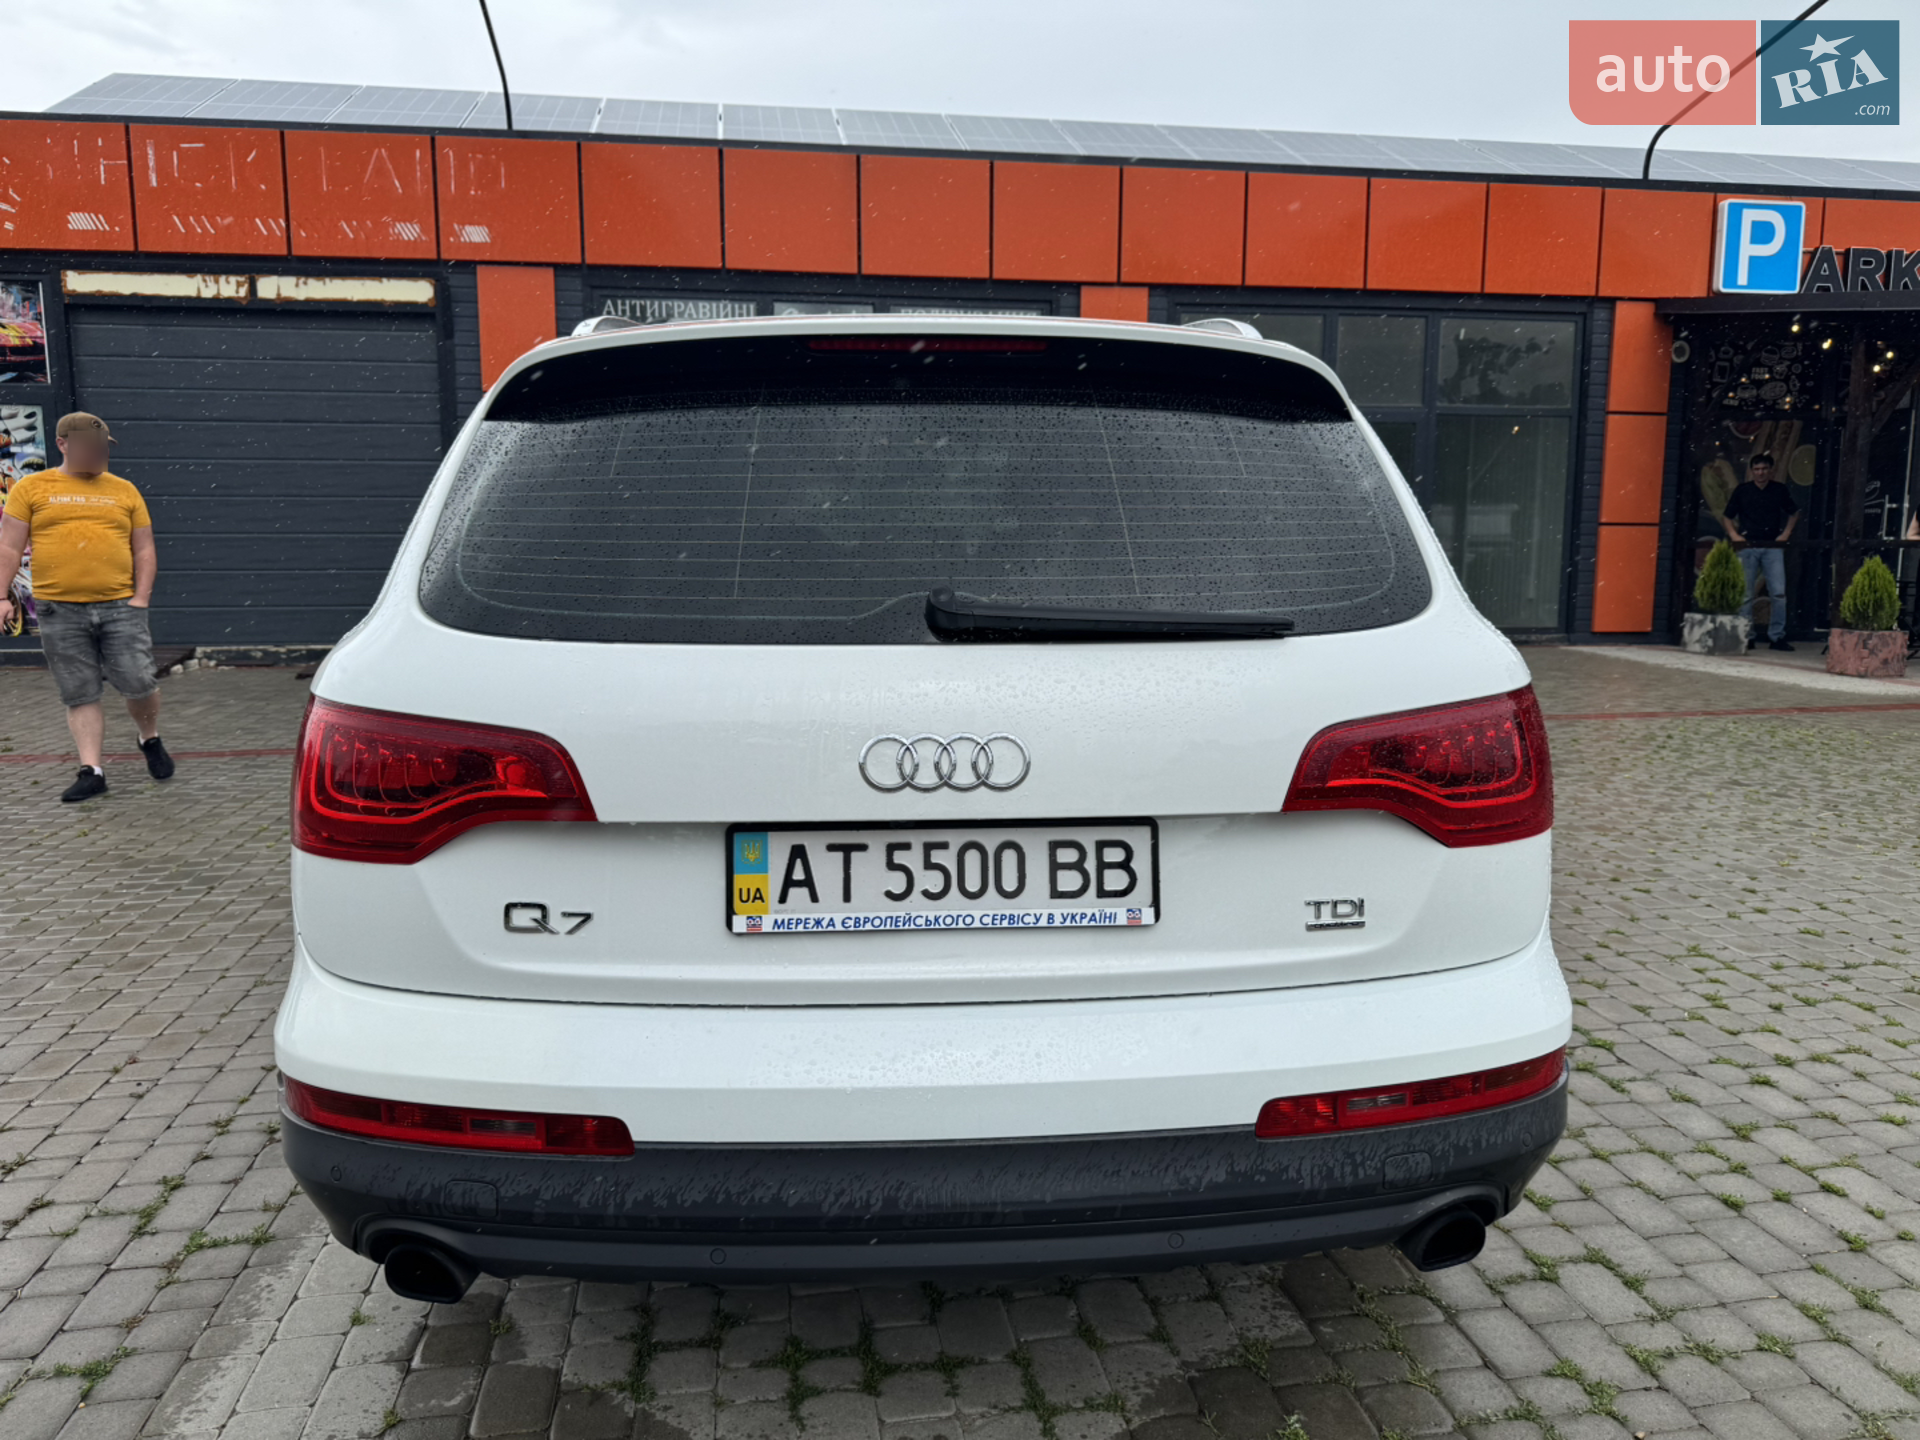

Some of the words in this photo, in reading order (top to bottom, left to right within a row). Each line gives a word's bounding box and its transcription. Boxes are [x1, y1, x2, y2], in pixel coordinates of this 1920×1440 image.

[1736, 208, 1787, 286] P
[602, 299, 756, 319] АНТИГРАВІЙНІ
[778, 842, 869, 904] AT
[884, 840, 1027, 902] 5500
[1049, 839, 1139, 900] BB
[738, 887, 765, 904] UA
[503, 901, 594, 935] Q7
[1304, 897, 1365, 919] TDI
[772, 916, 837, 931] МЕРЕЖА
[841, 912, 976, 930] ЄВРОПЕЙСЬКОГО
[979, 913, 1043, 926] СЕРВІСУ
[1047, 912, 1056, 925] В
[1060, 909, 1117, 925] УКРАЇНІ
